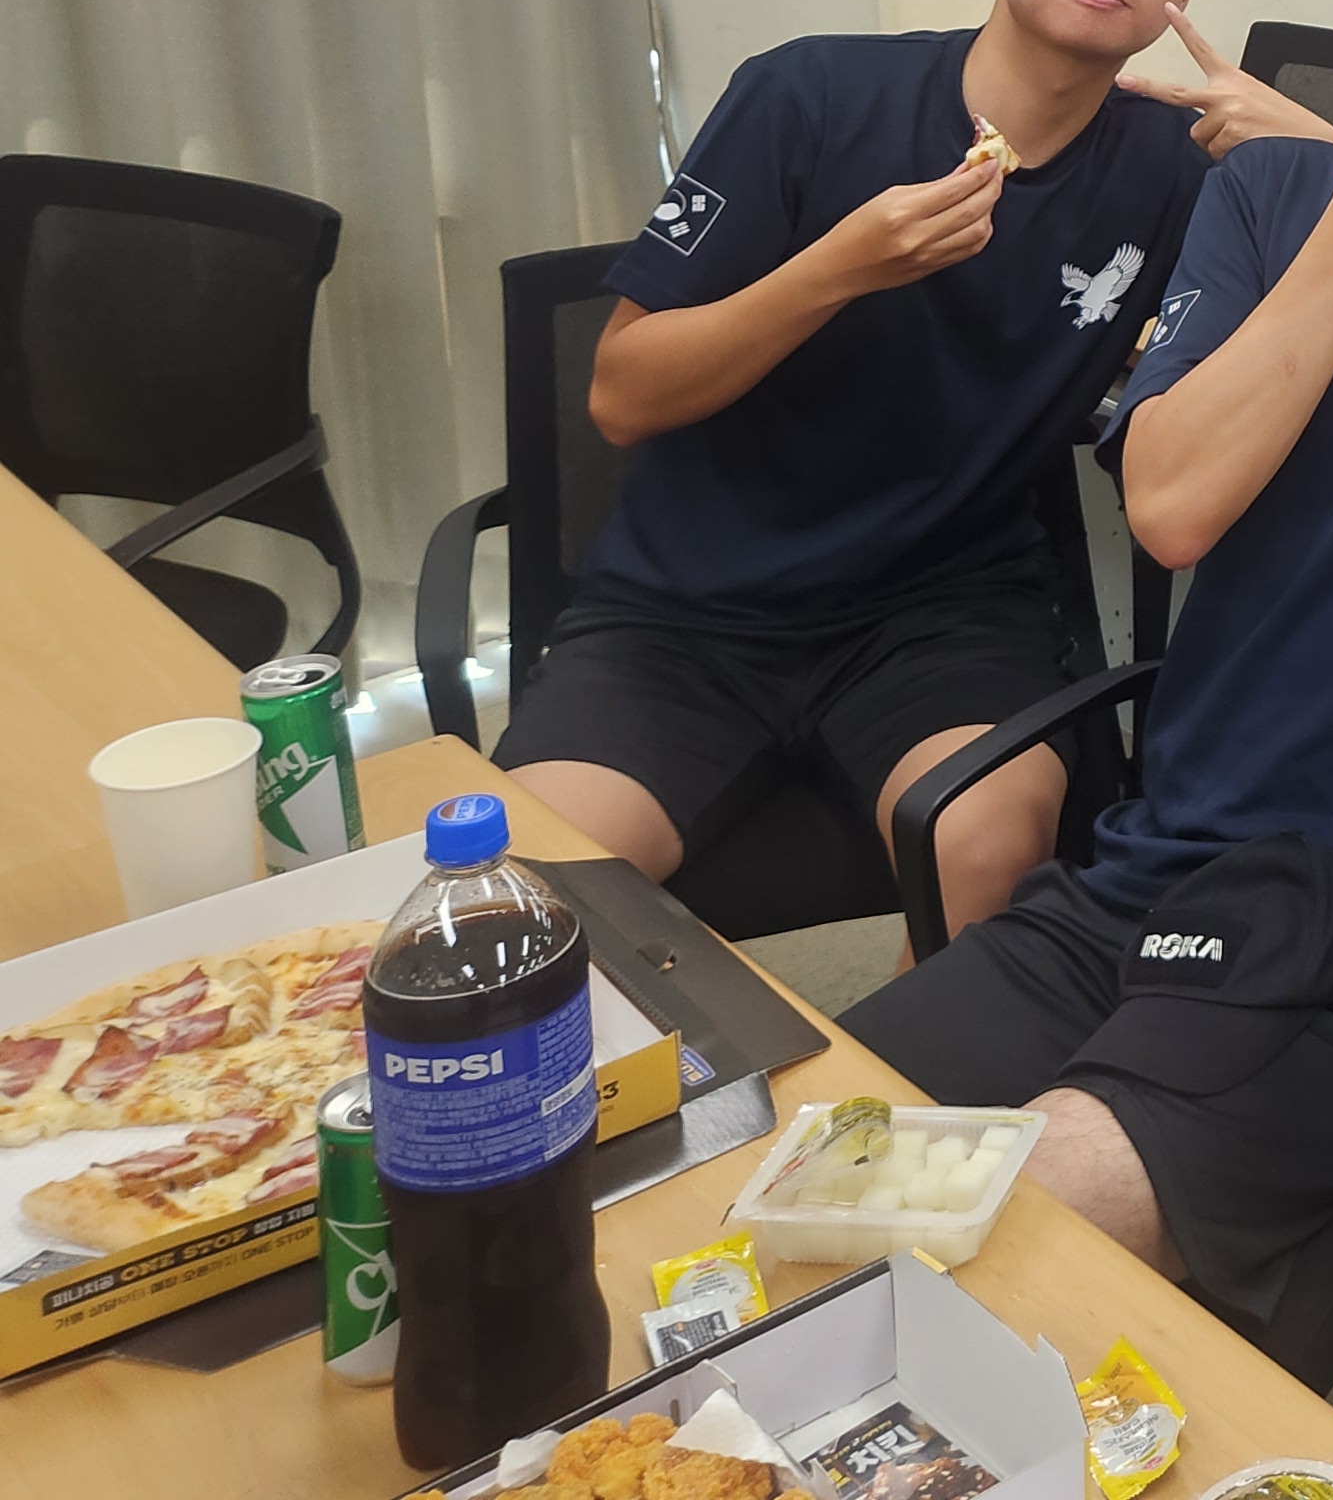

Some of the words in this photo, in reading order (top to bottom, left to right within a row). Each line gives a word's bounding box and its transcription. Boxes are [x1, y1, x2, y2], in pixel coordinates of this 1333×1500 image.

[1139, 932, 1224, 962] ROKA
[384, 1048, 504, 1084] PEPSI
[120, 1251, 176, 1282] ONE
[182, 1228, 249, 1261] STOP
[242, 1241, 273, 1261] ONE
[276, 1226, 314, 1248] STOP
[847, 1424, 925, 1474] 치킨
